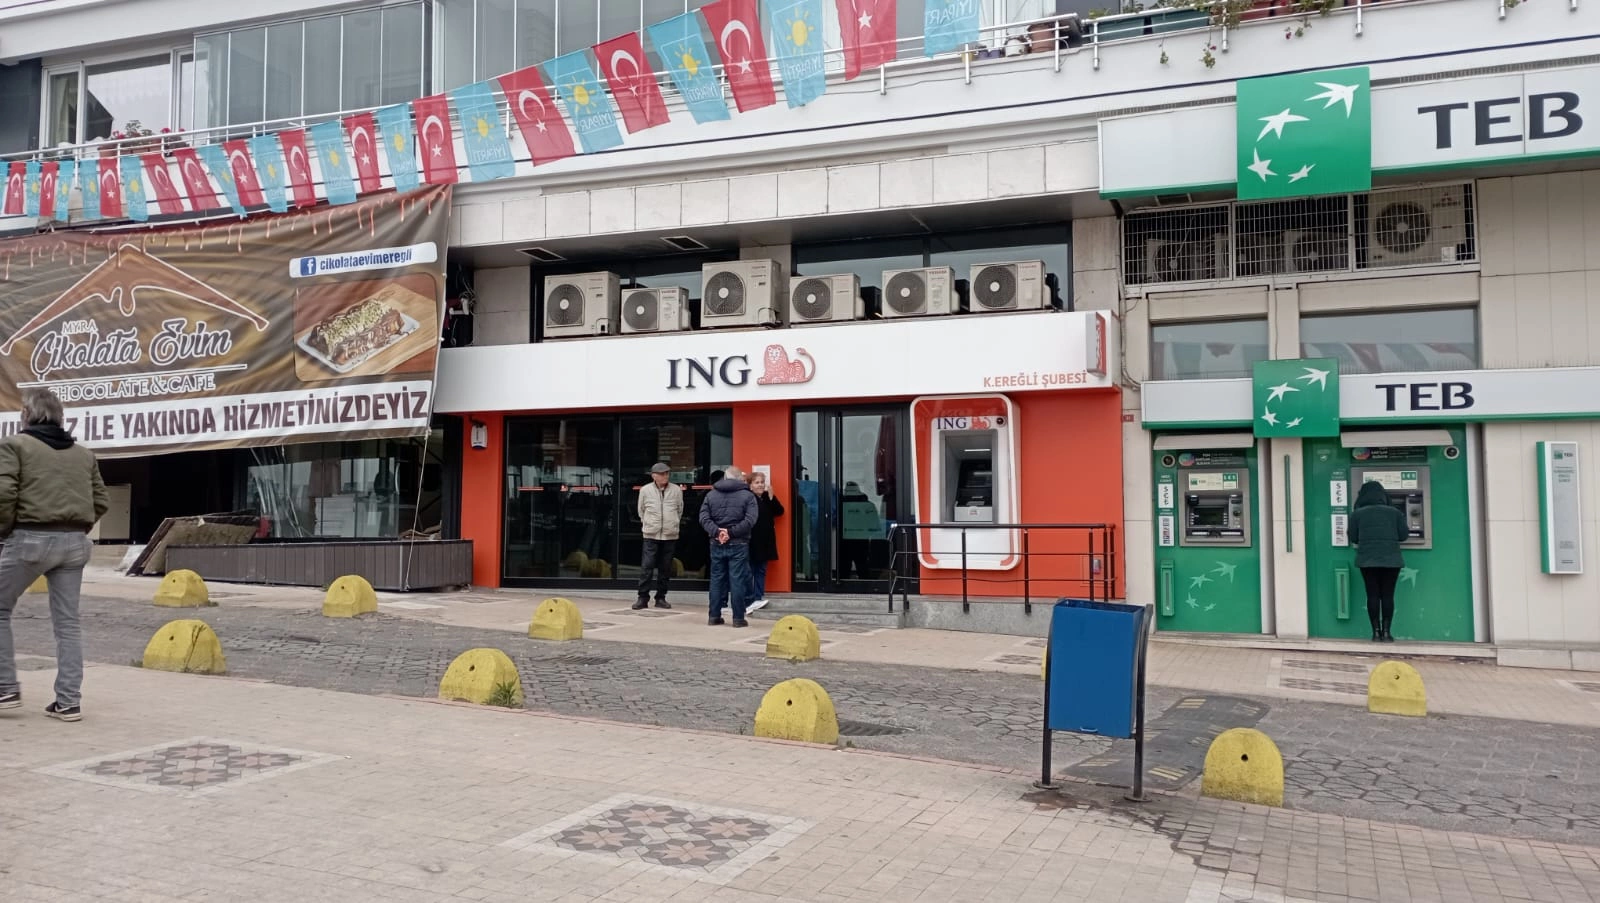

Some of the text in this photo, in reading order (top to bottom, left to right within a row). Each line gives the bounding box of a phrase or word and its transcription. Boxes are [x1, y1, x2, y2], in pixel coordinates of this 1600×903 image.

[1417, 91, 1583, 149] TEB
[319, 249, 412, 271] cikolataevimeregli
[61, 319, 98, 334] MYRA
[31, 318, 232, 382] Çikolata Evim
[666, 354, 752, 389] ING
[983, 370, 1087, 388] K.EREĞLİ ŞUBESİ
[1375, 382, 1474, 411] TEB
[84, 410, 114, 441] İLE
[121, 407, 216, 439] YAKINDA
[224, 386, 428, 431] HİZMETİNİZDEYİZ
[937, 418, 967, 430] ING
